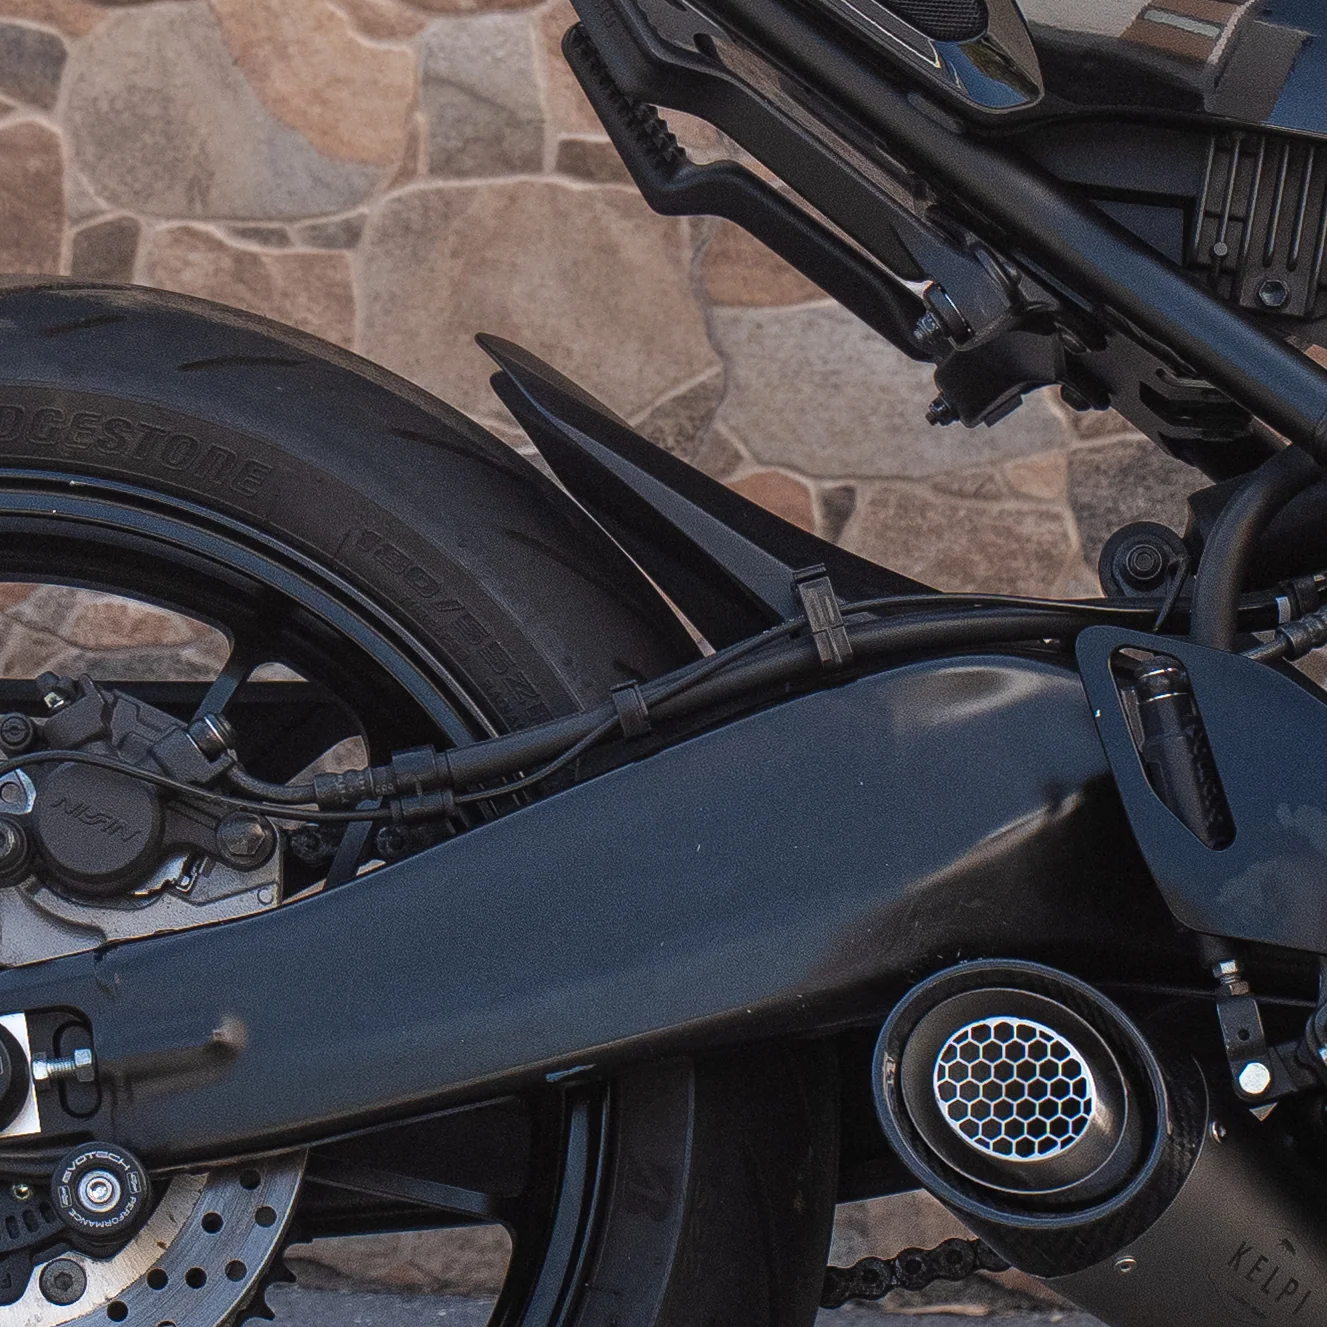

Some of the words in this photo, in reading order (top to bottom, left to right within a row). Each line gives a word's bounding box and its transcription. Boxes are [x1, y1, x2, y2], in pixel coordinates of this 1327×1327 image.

[50, 796, 143, 843] NISSIN
[61, 1150, 131, 1184] EVOTECH
[67, 1195, 138, 1229] PERFORMANCE
[1226, 1240, 1313, 1316] KELPI
